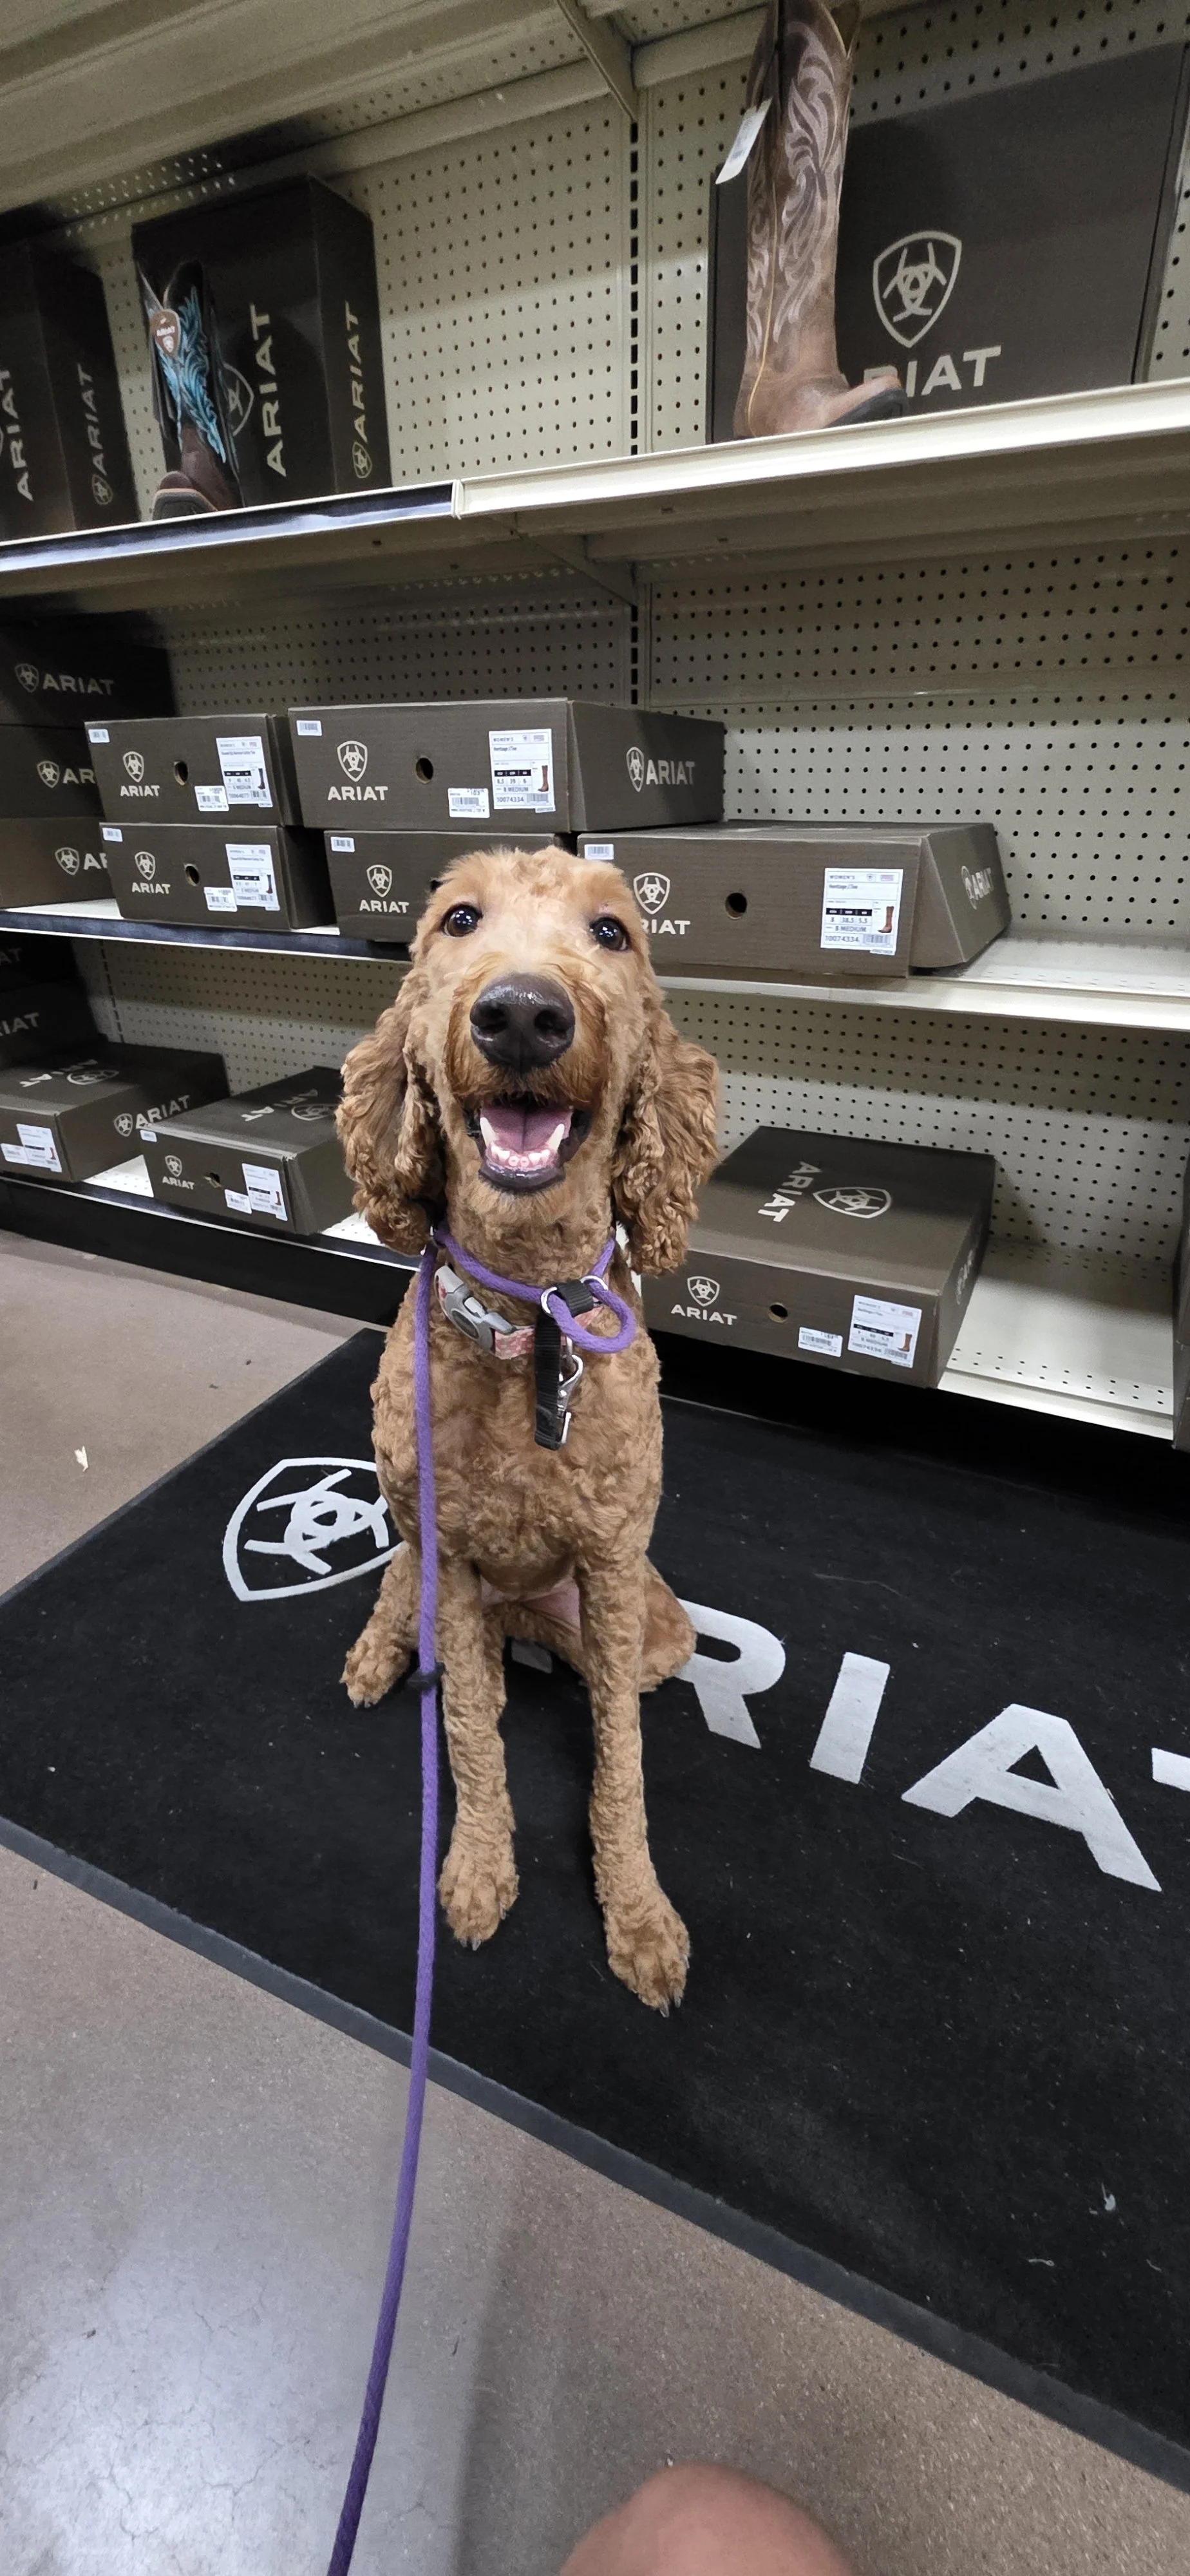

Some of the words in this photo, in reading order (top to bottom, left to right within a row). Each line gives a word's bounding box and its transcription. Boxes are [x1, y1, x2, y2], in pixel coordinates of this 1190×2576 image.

[345, 300, 368, 442] ARIAT
[250, 303, 287, 477] ARIAT
[77, 363, 107, 476] ARIAT
[42, 673, 115, 696] ARIAT
[646, 759, 695, 785] ARIAT
[120, 784, 160, 797] ARIAT
[328, 786, 388, 801] ARIAT
[132, 882, 171, 895] ARIAT
[359, 899, 409, 914] ARIAT
[641, 918, 691, 935] RIAT
[135, 1095, 190, 1130] ARIAT
[162, 1175, 194, 1190] ARIAT
[757, 1161, 822, 1222] ARIAT
[671, 1303, 737, 1327] ARIAT
[512, 1597, 1190, 1891] RIA
